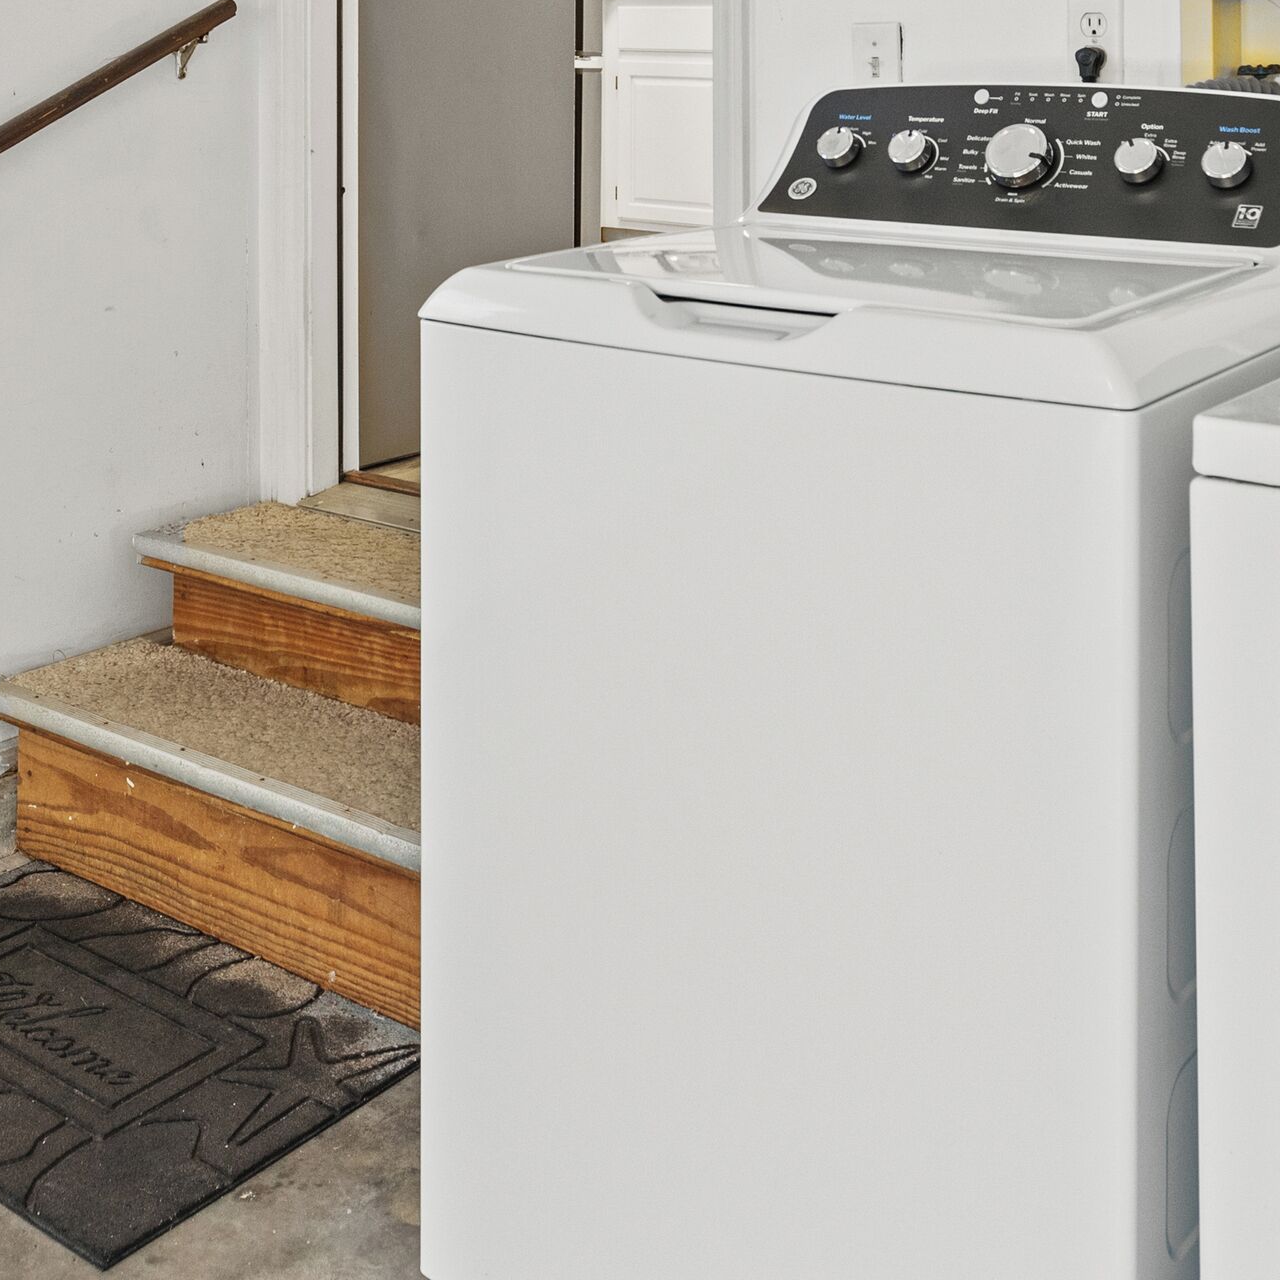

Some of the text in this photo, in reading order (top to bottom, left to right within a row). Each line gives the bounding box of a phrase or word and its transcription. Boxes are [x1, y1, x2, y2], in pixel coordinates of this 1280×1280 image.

[973, 107, 989, 115] Deep
[908, 115, 945, 123] Temperature
[1141, 123, 1164, 131] Option
[1239, 126, 1261, 134] Boost
[962, 148, 979, 156] Bulky
[1075, 153, 1098, 161] Whites
[1239, 207, 1261, 221] 10
